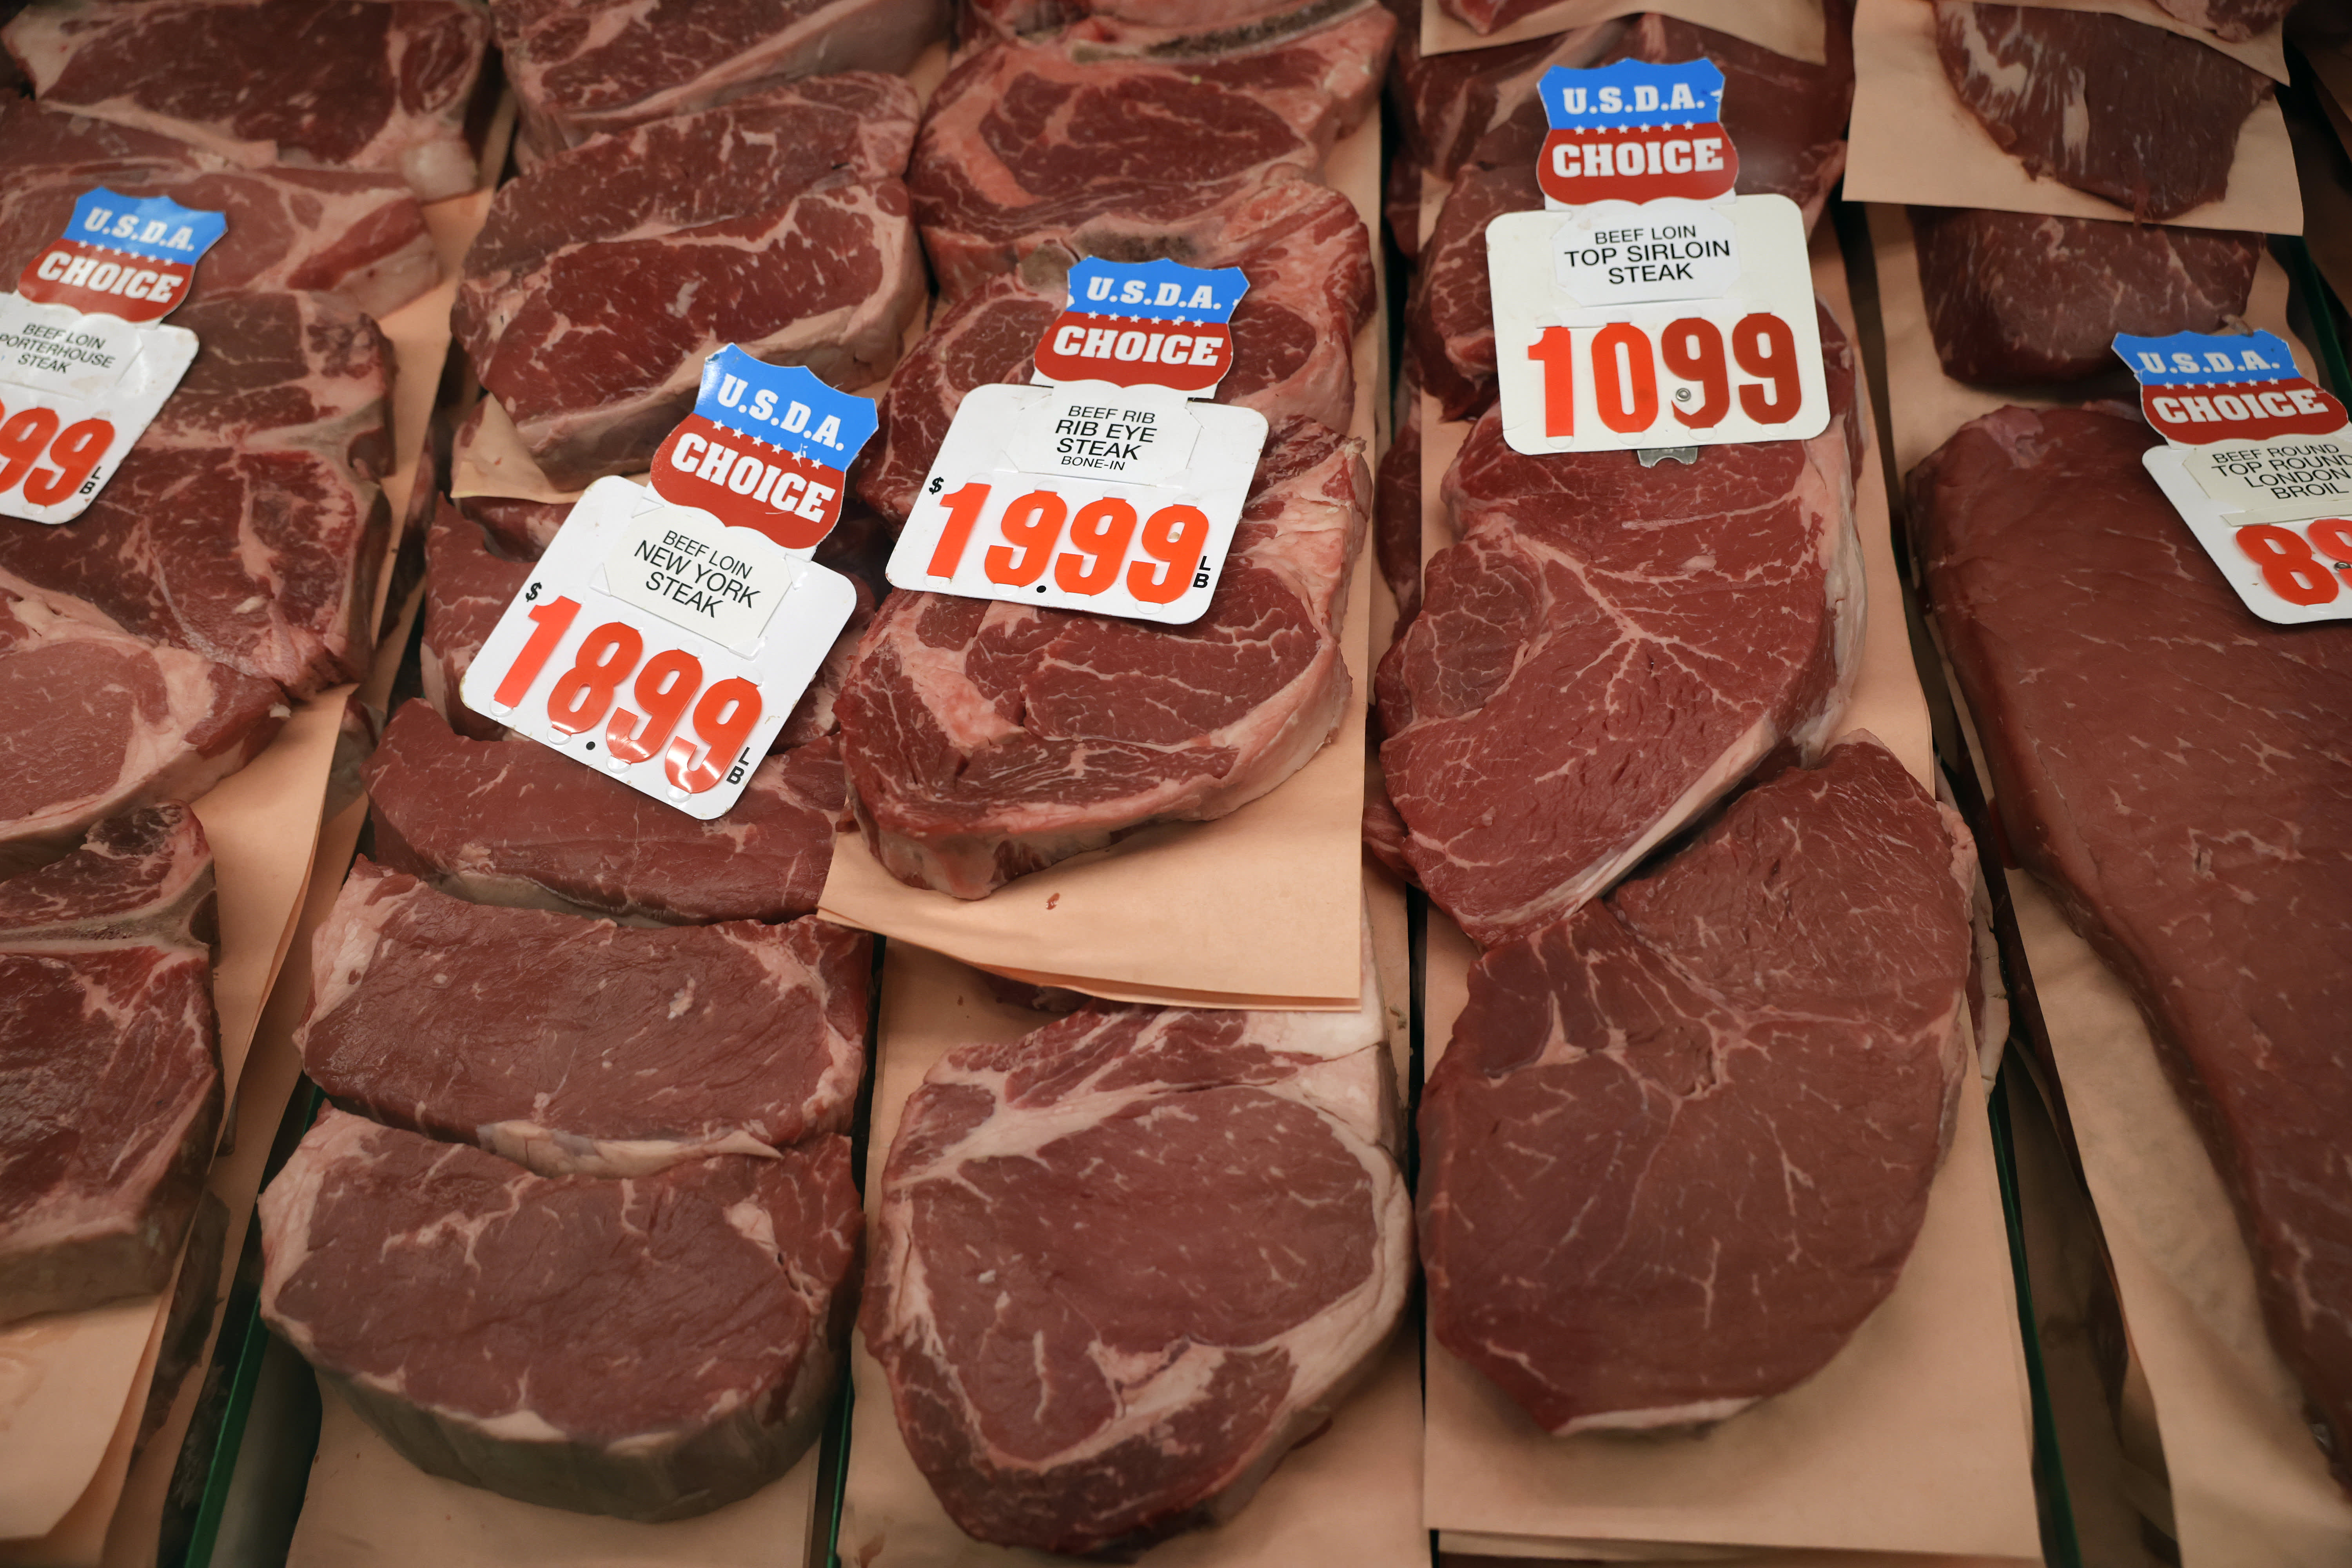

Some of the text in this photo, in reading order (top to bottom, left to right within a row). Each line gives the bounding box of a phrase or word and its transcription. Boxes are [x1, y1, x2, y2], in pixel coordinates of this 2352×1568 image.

[1563, 83, 1705, 115] U.S.D.A.
[1552, 138, 1724, 178] CHOICE
[84, 207, 195, 252] U.S.D.A.
[1595, 225, 1696, 245] BEEF LOIN
[1564, 240, 1731, 268] TOP SIRLOIN
[37, 251, 184, 303] CHOICE
[1608, 263, 1694, 285] STEAK
[1086, 276, 1222, 310] U.S.D.A.
[22, 322, 106, 350] BEEF LOIN
[1052, 325, 1225, 367] CHOICE
[18, 352, 72, 374] STEAK
[2136, 350, 2280, 374] U.S.D.A.
[717, 374, 845, 451] U.S.D.A.
[1068, 406, 1156, 423] BEEF RIB
[2152, 388, 2329, 424] CHOICE
[1055, 419, 1158, 443] RIB EYE
[0, 397, 116, 506] 99
[1056, 439, 1142, 461] STEAK
[1061, 456, 1125, 471] BONE-IN
[2212, 444, 2339, 463] BEEF ROUND
[670, 432, 836, 524] CHOICE
[2211, 455, 2352, 477] TOP ROUND
[2244, 468, 2352, 488] LONDON
[2270, 483, 2349, 499] BROIL
[663, 530, 753, 579] BEEF LOIN
[634, 541, 761, 609] NEW YORK
[645, 571, 723, 619] STEAK
